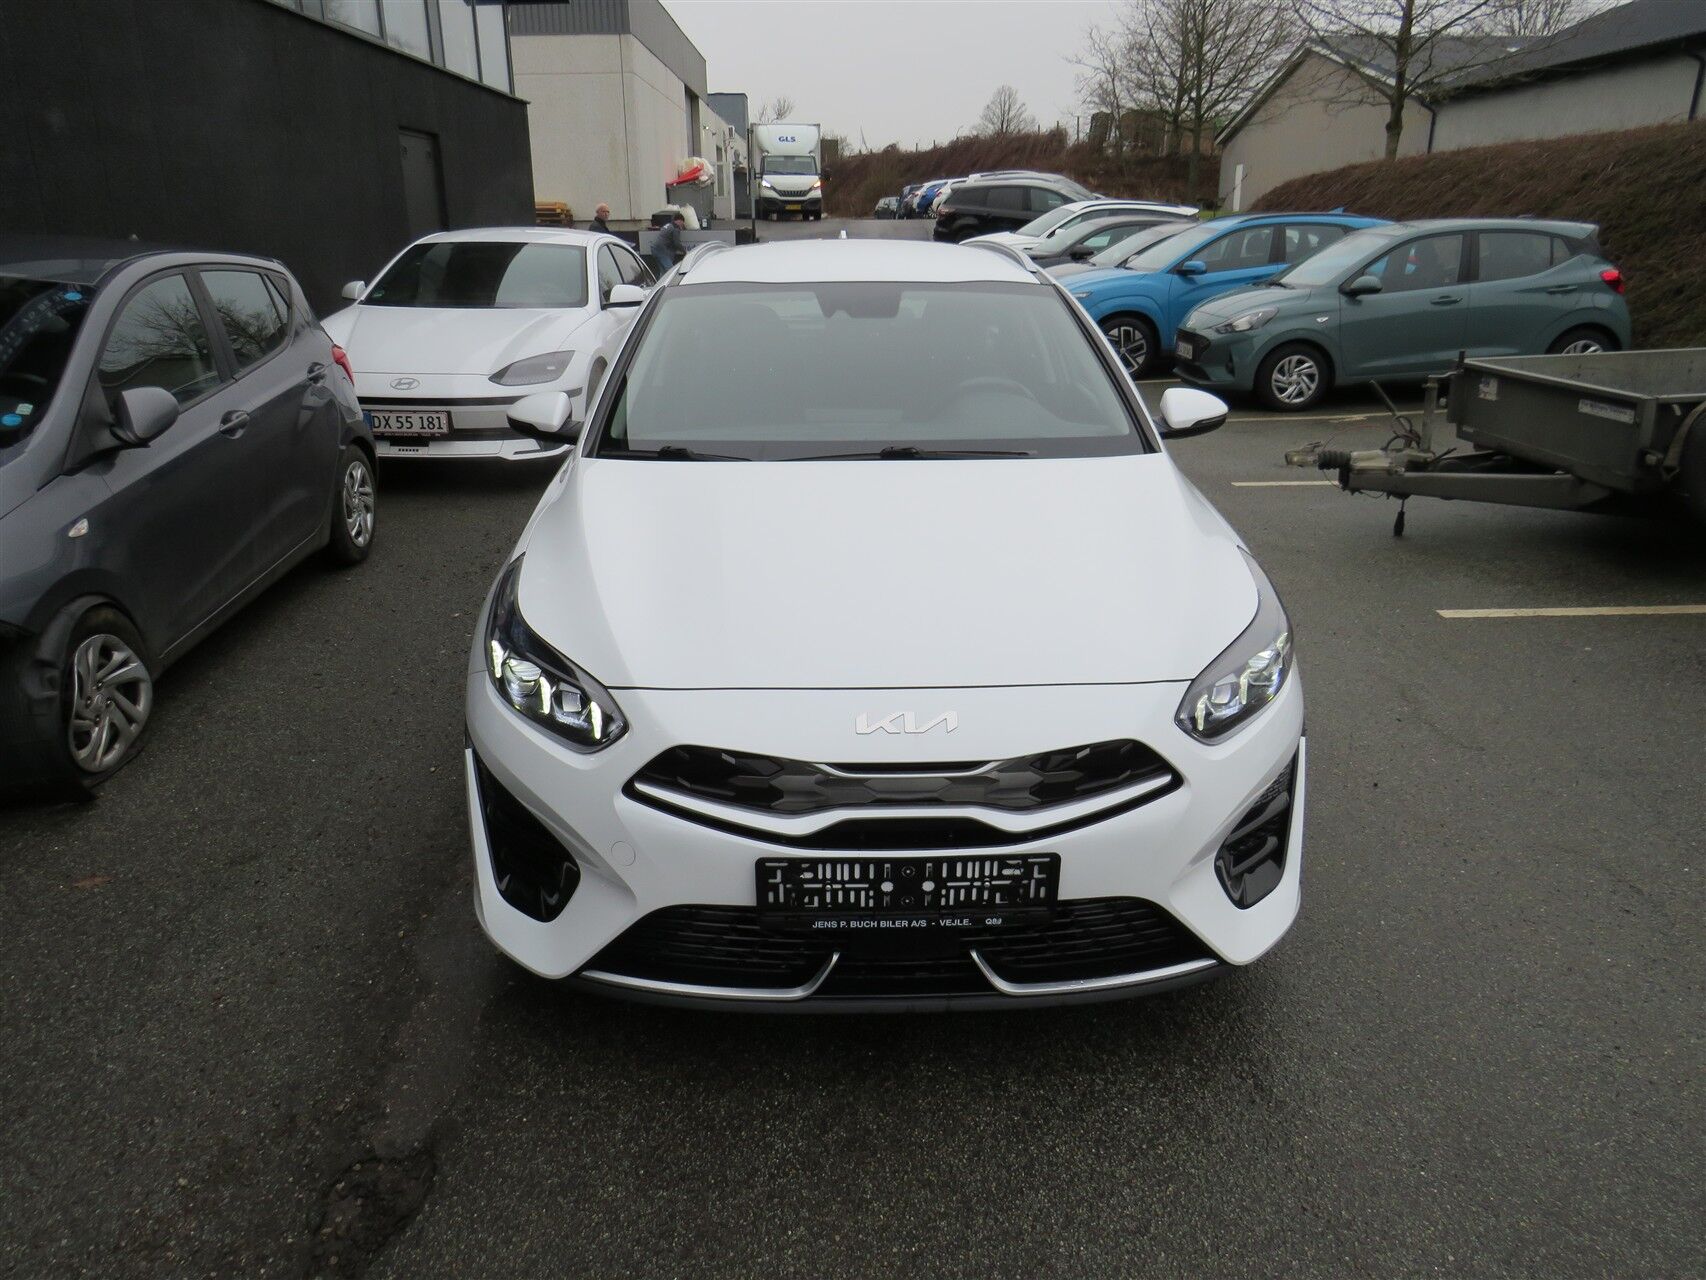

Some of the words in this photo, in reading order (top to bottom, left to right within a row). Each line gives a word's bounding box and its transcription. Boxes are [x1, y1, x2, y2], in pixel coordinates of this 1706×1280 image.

[372, 415, 392, 429] DX
[396, 415, 414, 430] 55
[419, 416, 443, 430] 181
[855, 711, 959, 735] KIA
[812, 921, 838, 929] JENS
[850, 920, 878, 928] BUCH
[880, 920, 909, 928] BILER
[909, 920, 927, 928] A/S
